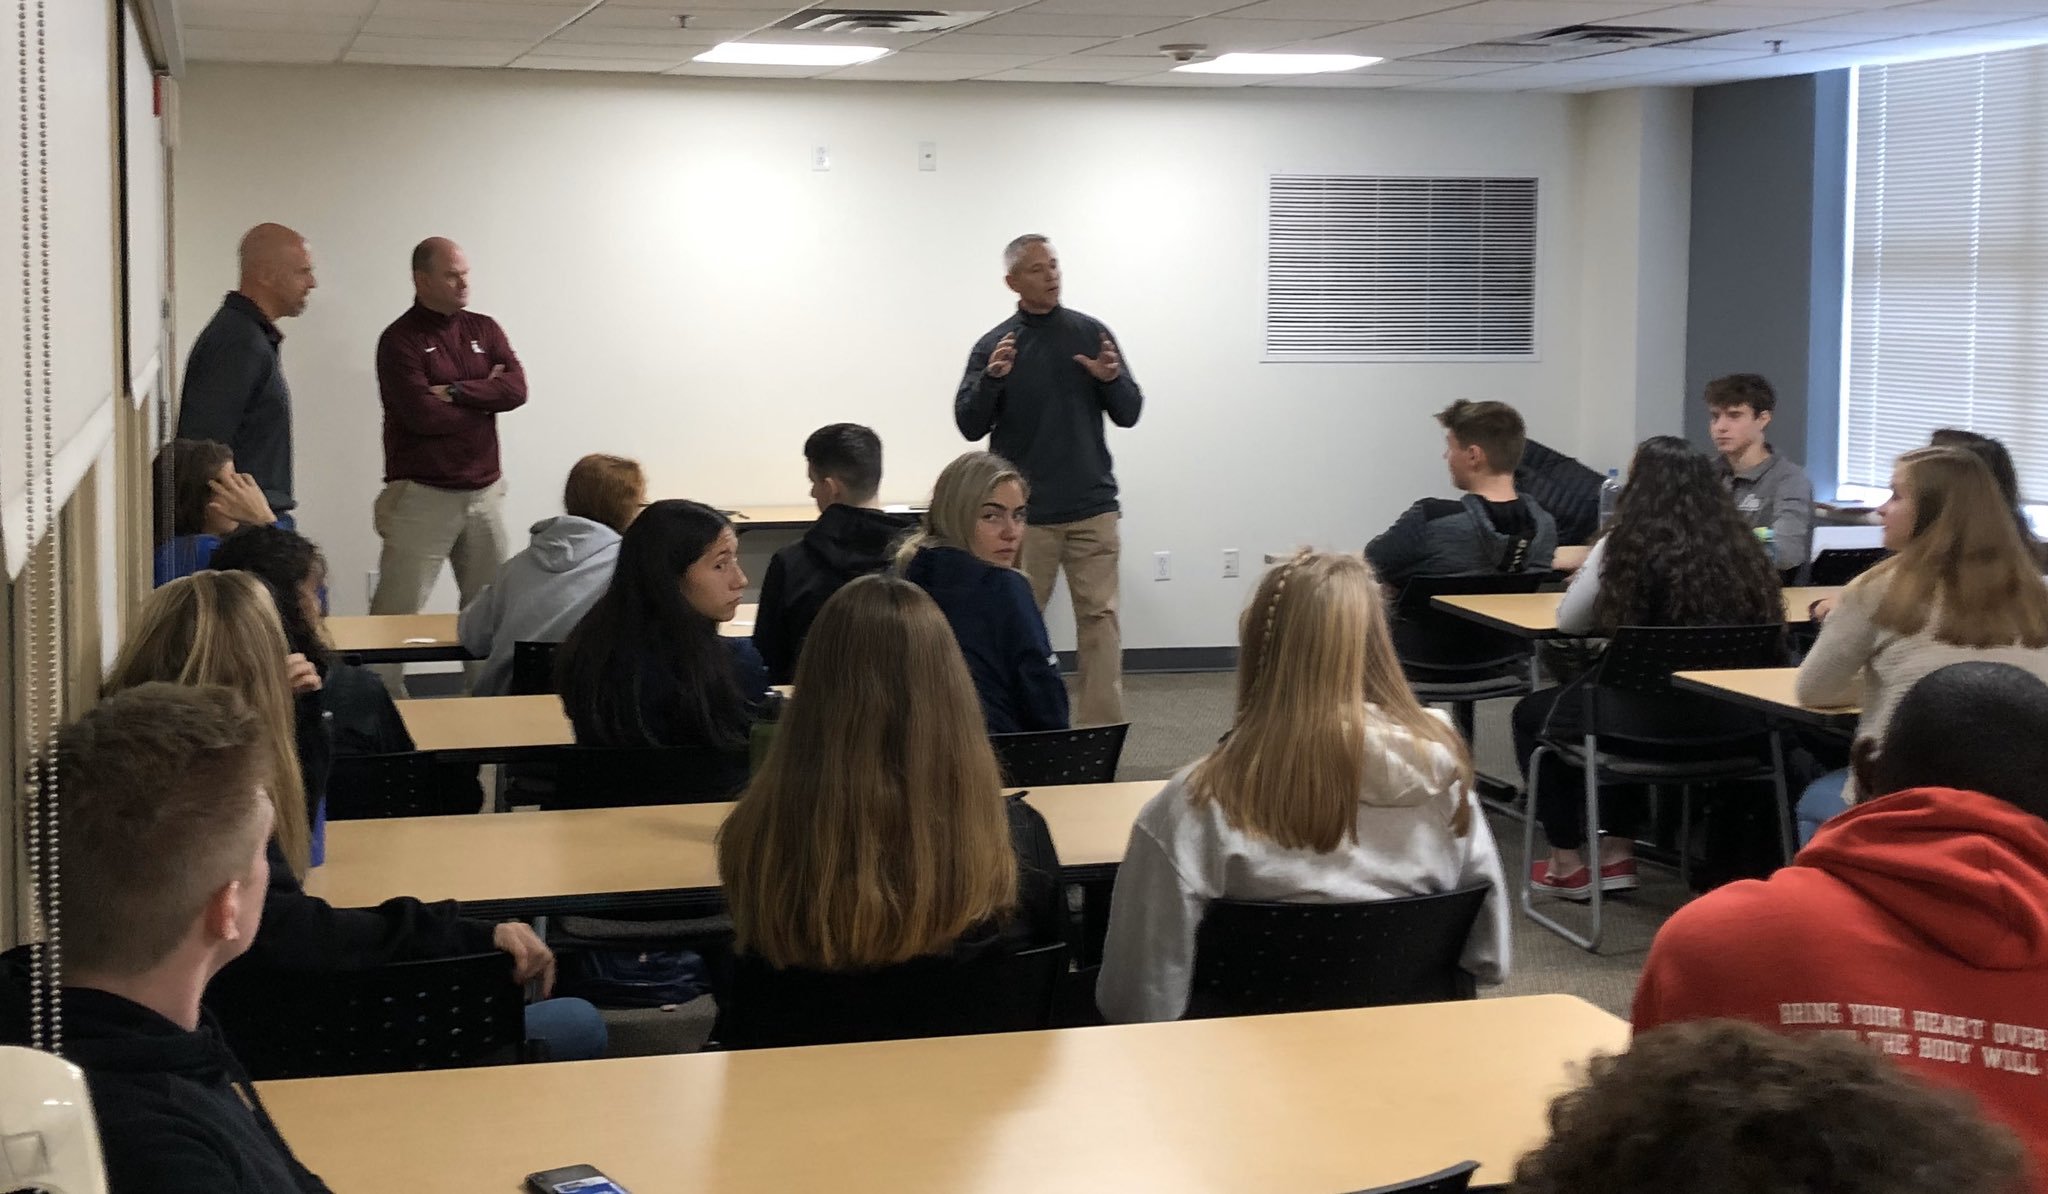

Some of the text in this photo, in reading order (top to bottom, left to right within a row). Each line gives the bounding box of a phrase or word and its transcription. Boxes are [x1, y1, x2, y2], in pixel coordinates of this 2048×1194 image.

[1779, 1002, 2048, 1051] BRING YOUR HEART OVER
[1919, 1037, 1974, 1064] BODY
[1981, 1046, 2042, 1076] WILL
